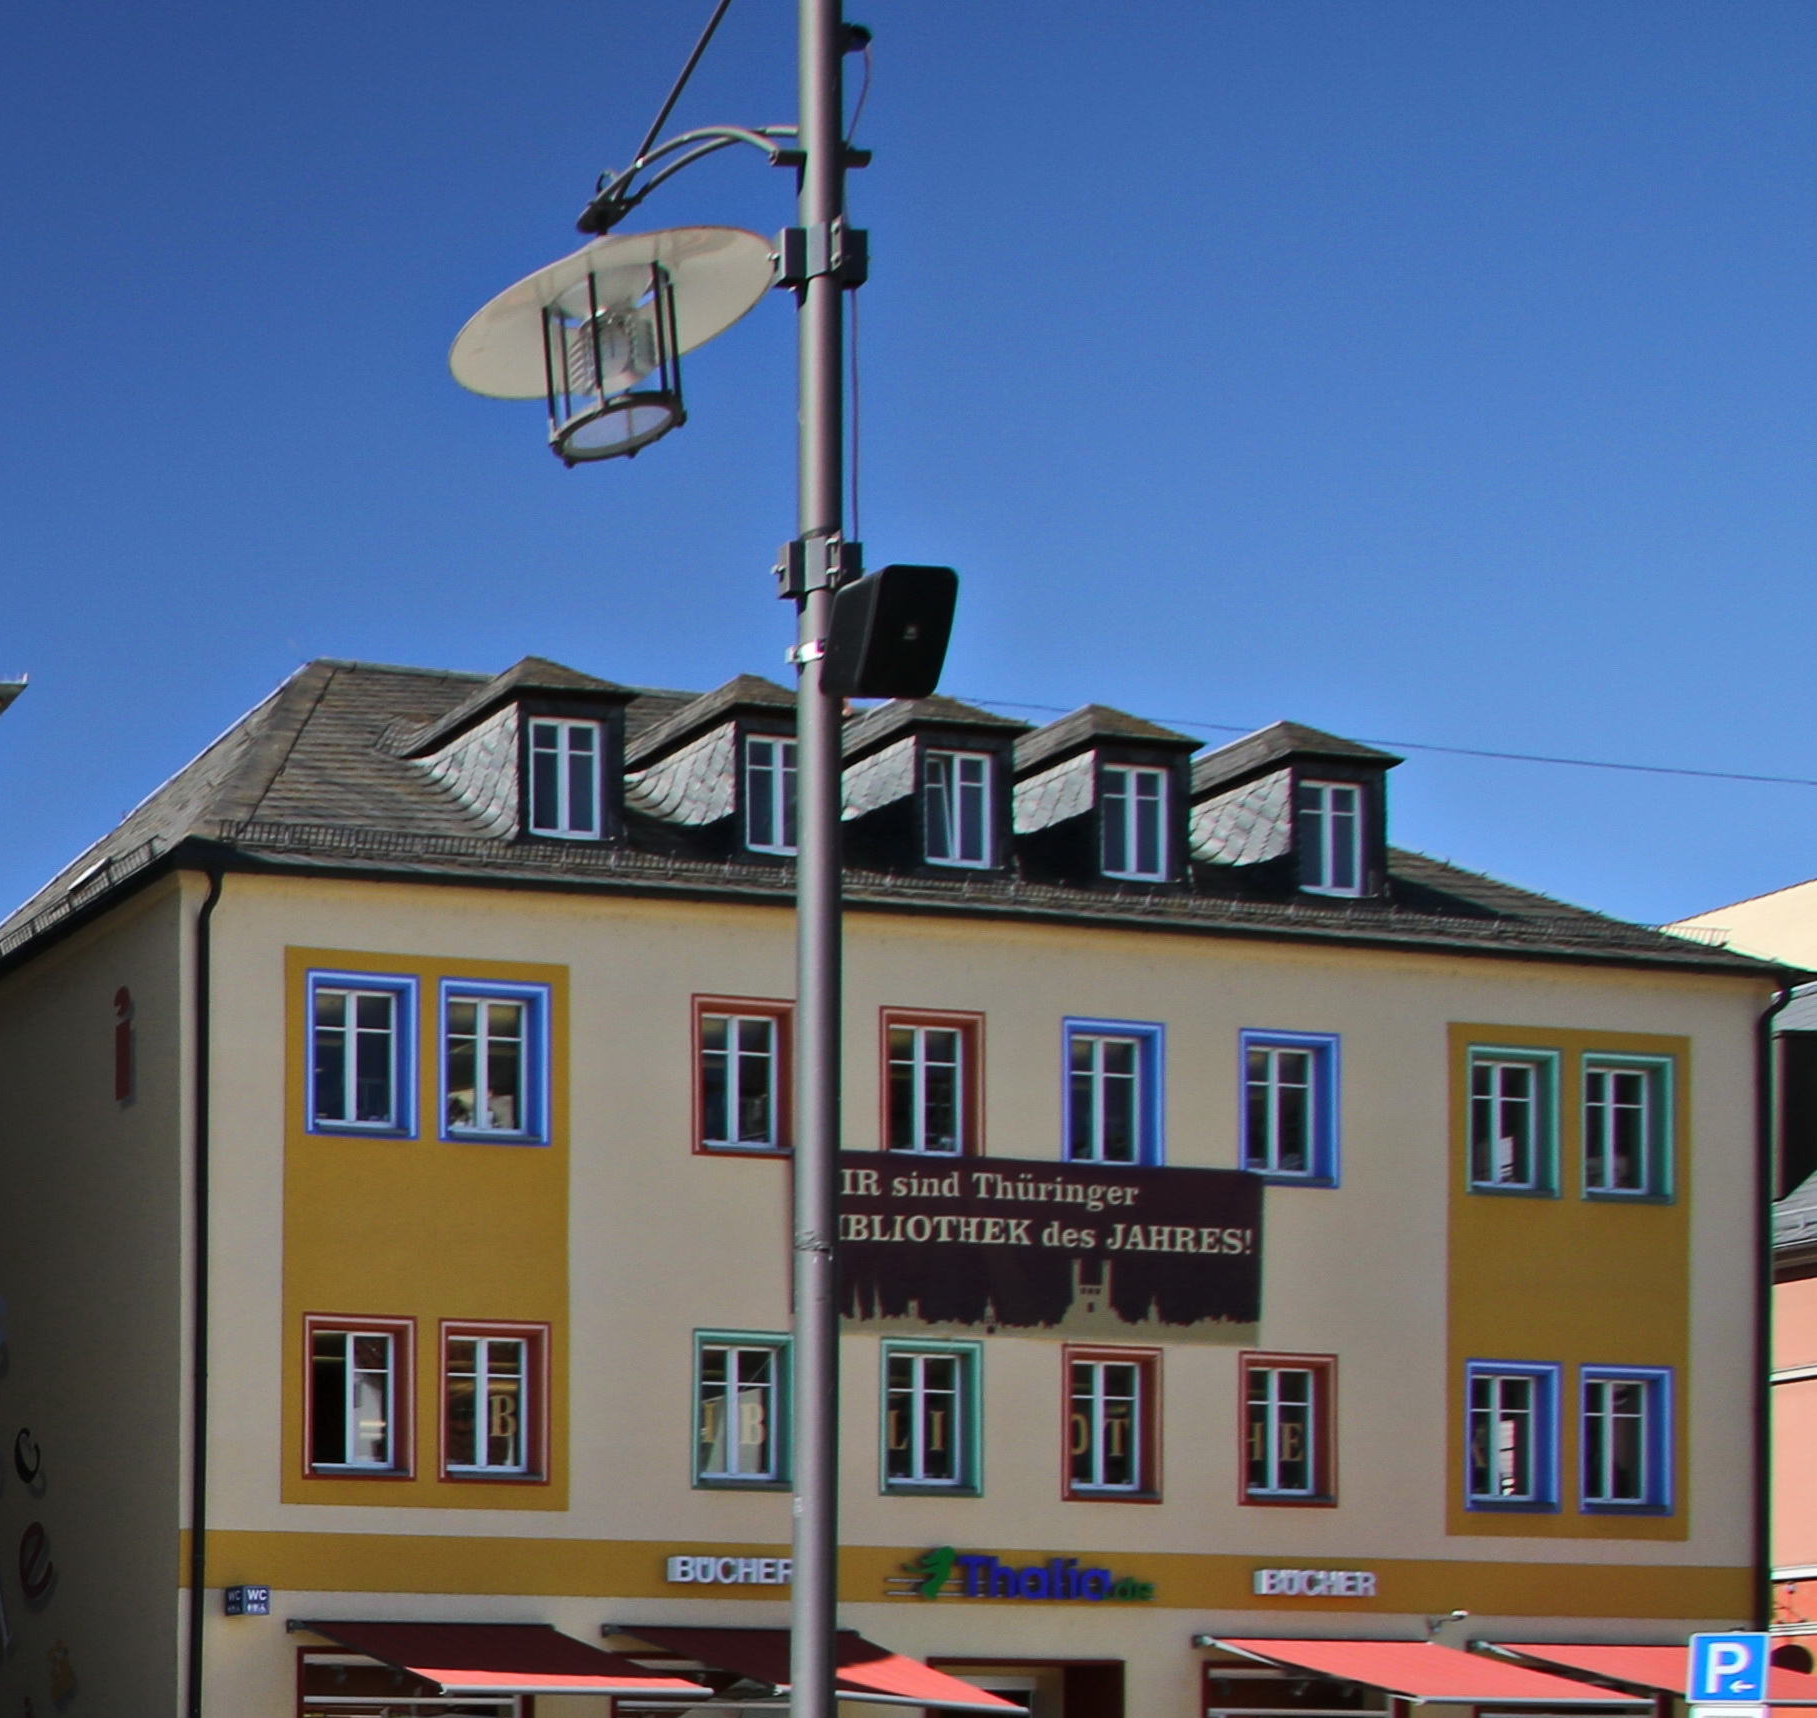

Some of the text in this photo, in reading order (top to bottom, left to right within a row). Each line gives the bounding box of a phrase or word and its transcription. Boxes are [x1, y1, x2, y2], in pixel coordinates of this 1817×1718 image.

[892, 1170, 961, 1198] sind
[972, 1171, 1139, 1212] Thüringer
[1042, 1220, 1096, 1249] des
[1107, 1222, 1254, 1256] JAHRES!
[228, 1590, 241, 1601] WC
[247, 1589, 267, 1601] WC
[1705, 1641, 1753, 1694] P
